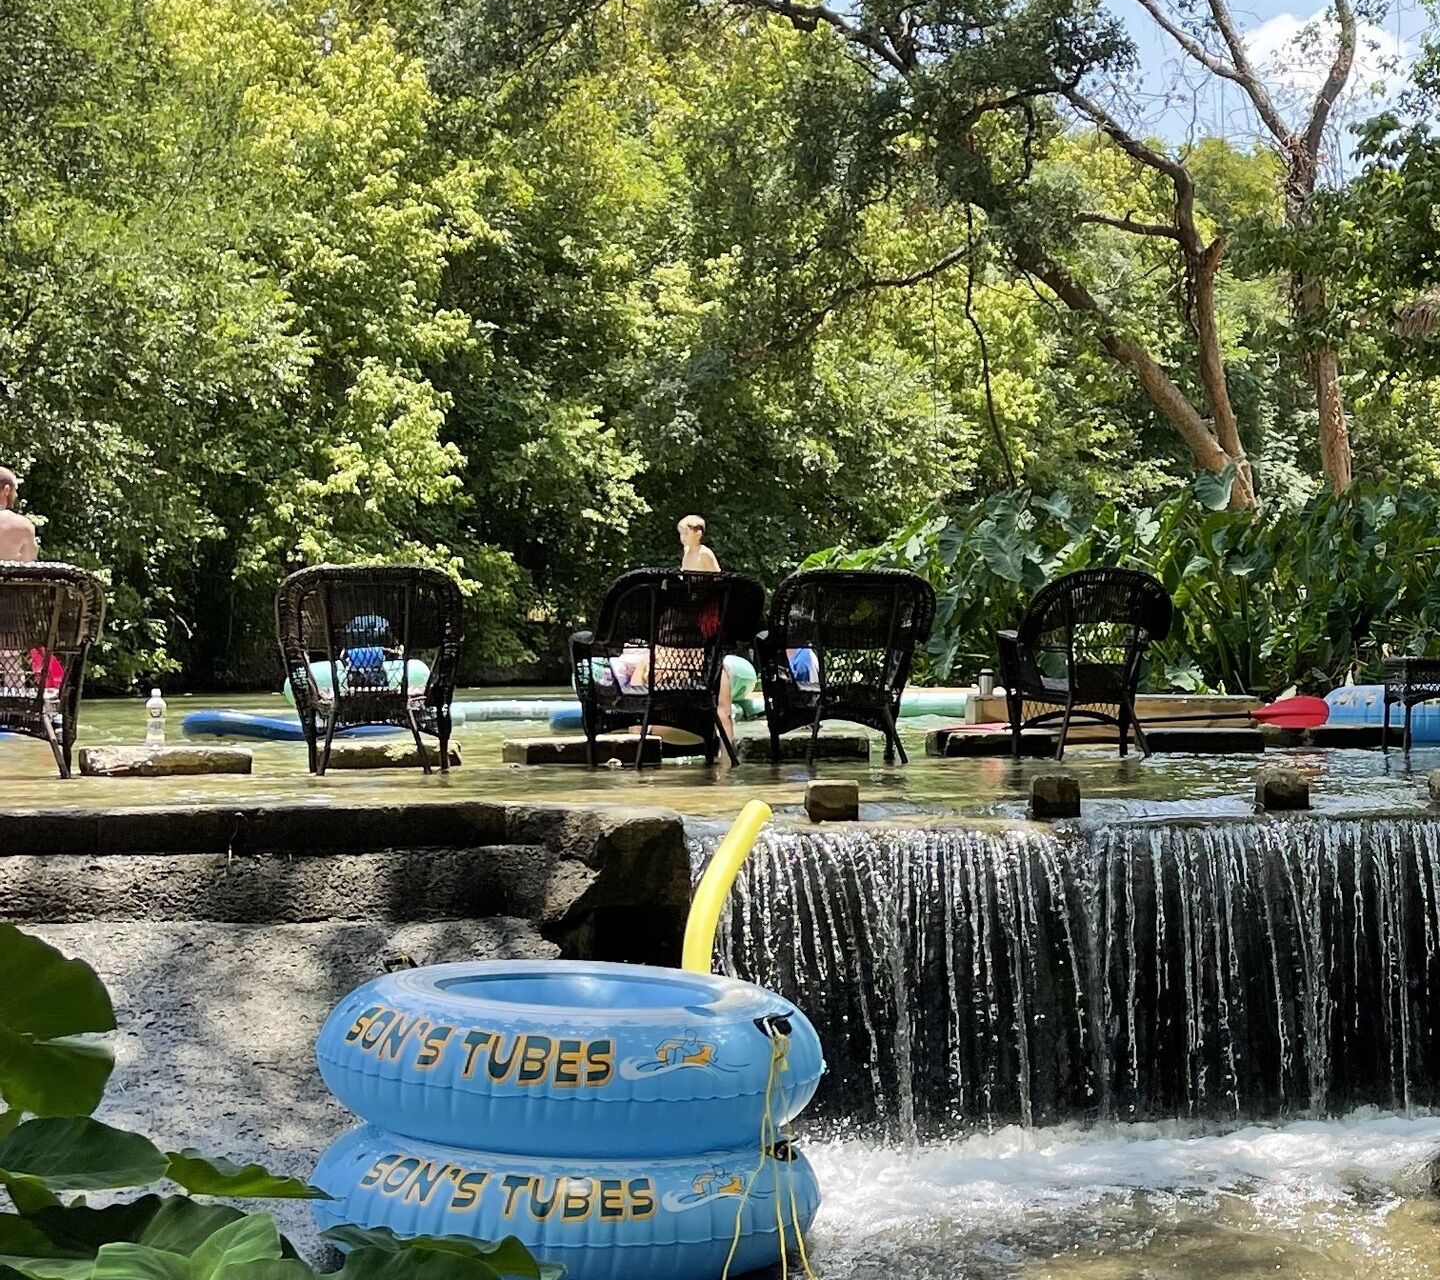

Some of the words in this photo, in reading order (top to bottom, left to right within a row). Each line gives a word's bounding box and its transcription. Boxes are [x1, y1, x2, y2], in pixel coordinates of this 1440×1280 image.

[345, 1004, 458, 1071] SON'S
[460, 1028, 618, 1089] TUBES
[360, 1152, 495, 1215] SON'S
[500, 1173, 660, 1224] TUBES
